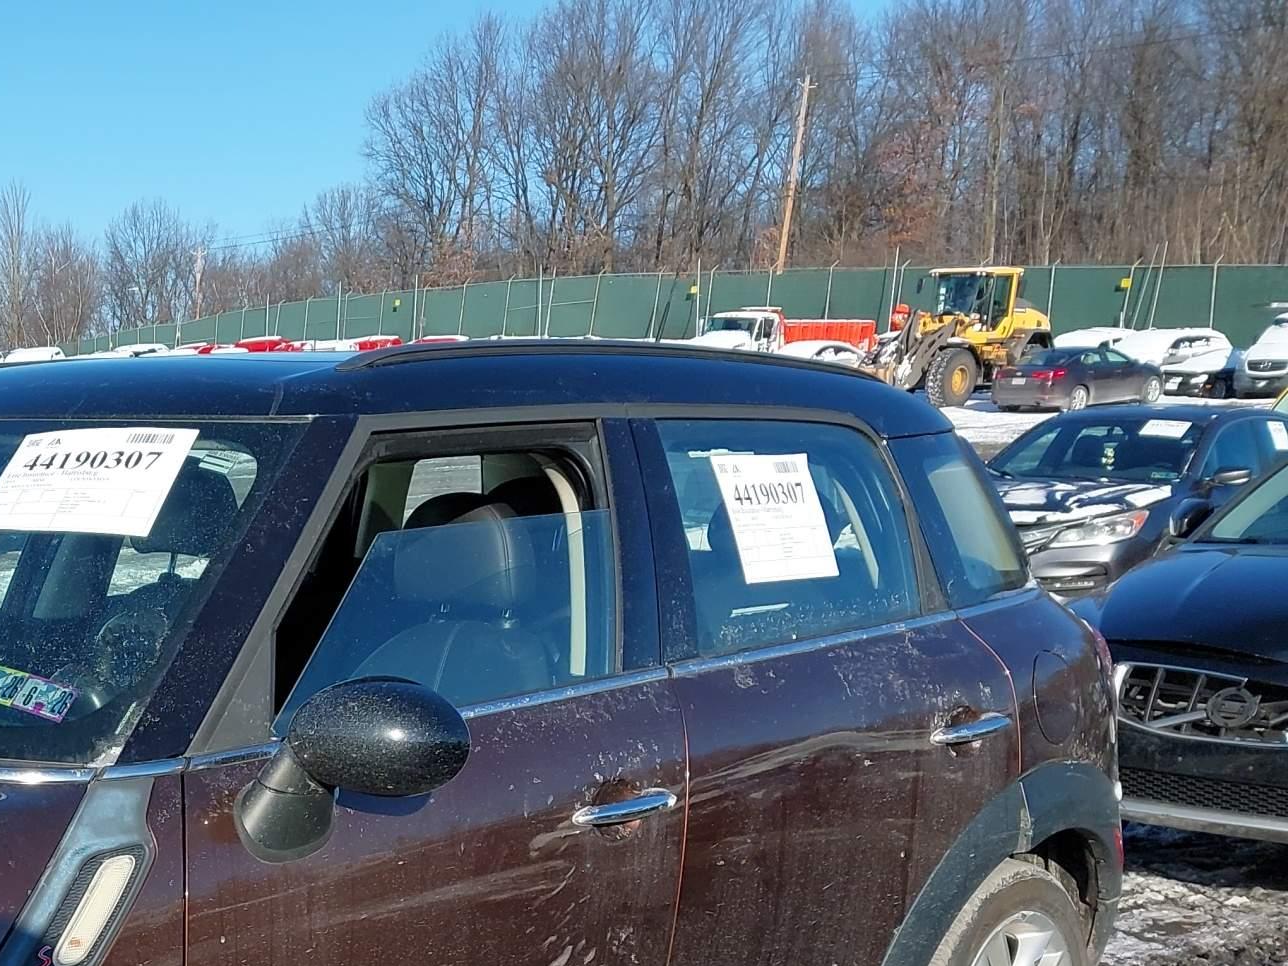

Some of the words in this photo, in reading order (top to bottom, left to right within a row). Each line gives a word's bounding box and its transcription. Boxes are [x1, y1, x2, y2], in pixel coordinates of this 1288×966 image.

[23, 450, 164, 471] 44190307
[733, 482, 806, 505] 44190307
[2, 675, 25, 700] 26
[23, 686, 39, 706] 6
[52, 690, 73, 715] 26
